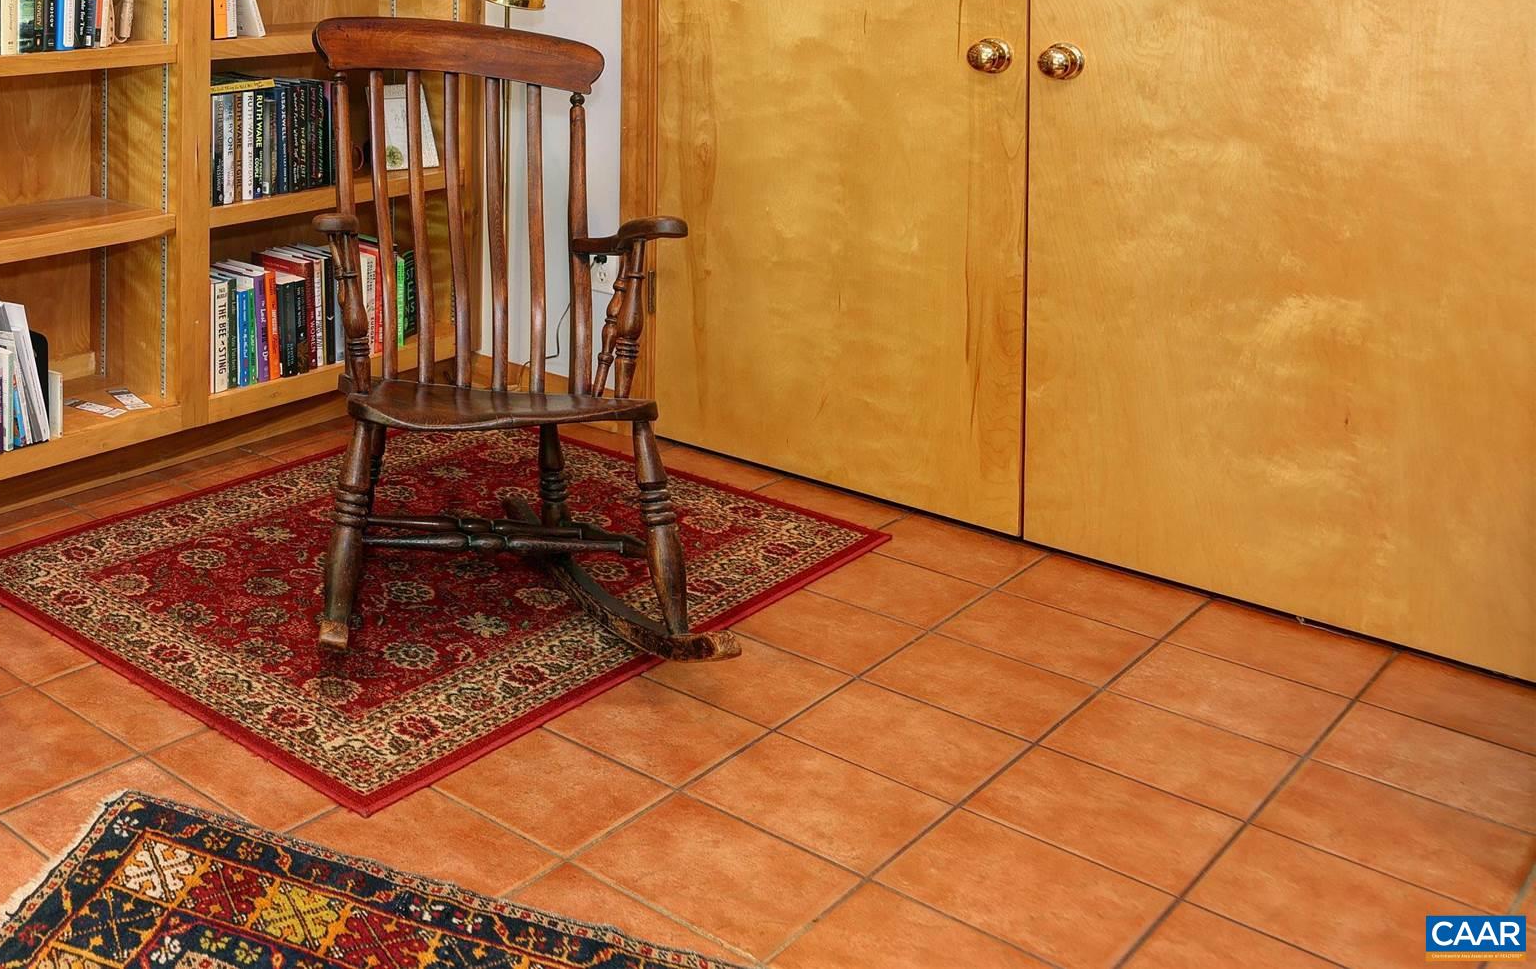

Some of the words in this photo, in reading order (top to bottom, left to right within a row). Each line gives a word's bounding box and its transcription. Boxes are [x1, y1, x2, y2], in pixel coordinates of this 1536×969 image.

[228, 123, 233, 133] BY
[218, 302, 227, 321] THE
[218, 323, 227, 337] BEE
[218, 347, 227, 375] STING
